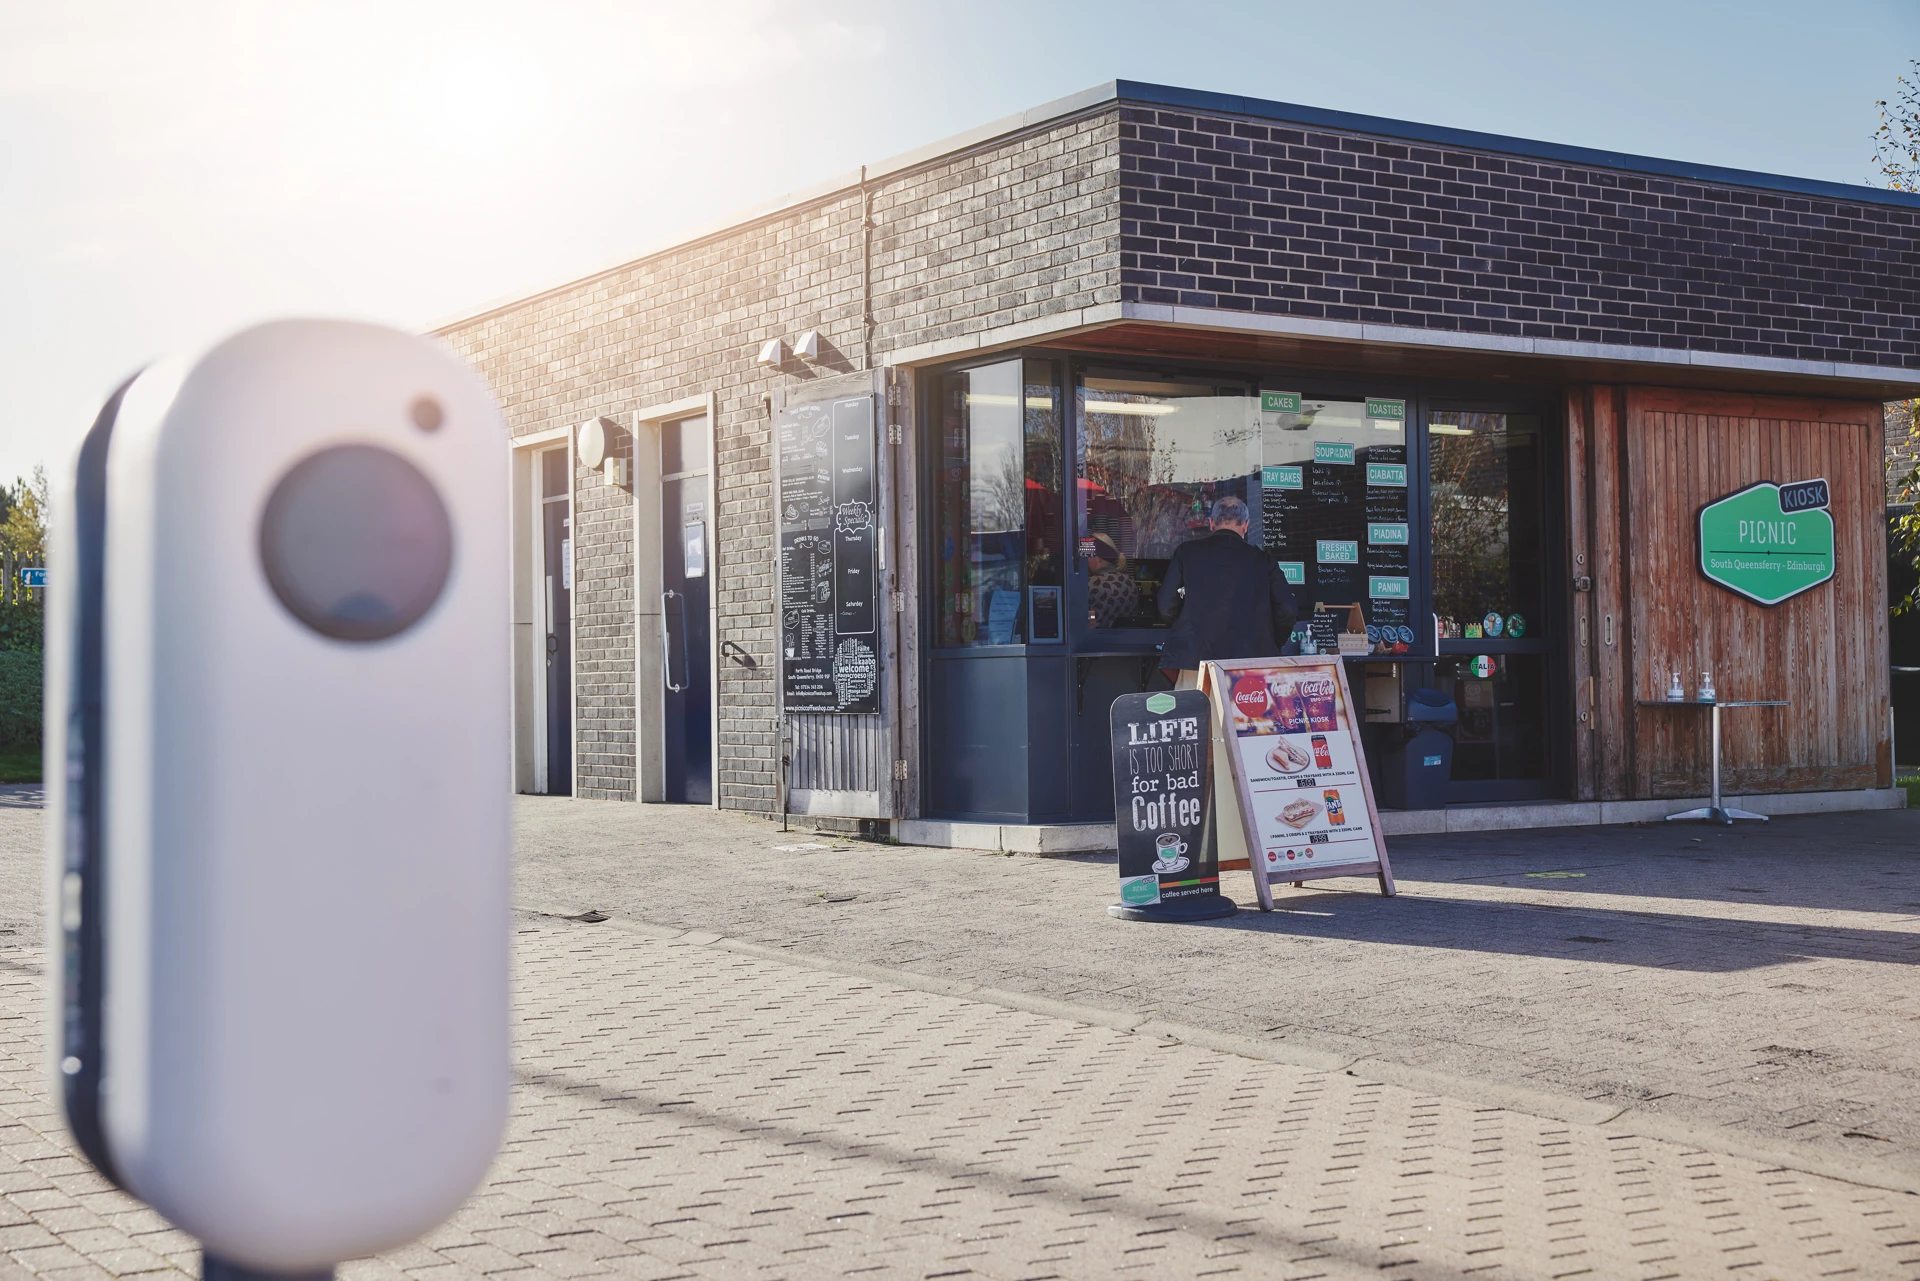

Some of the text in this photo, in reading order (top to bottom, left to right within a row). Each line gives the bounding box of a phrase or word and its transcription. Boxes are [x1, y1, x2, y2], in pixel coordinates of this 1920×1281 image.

[1268, 396, 1293, 408] CAKES
[1368, 403, 1402, 416] TOASTIES
[1316, 447, 1334, 458] SOUP
[1340, 448, 1352, 458] DAY
[1263, 472, 1300, 483] TRAY BAKES
[1370, 469, 1403, 480] CIABATTA
[1784, 486, 1825, 508] KIOSK
[842, 505, 862, 517] Weekly
[843, 516, 865, 527] Specials
[1374, 529, 1402, 539] PIADINA
[1739, 520, 1797, 545] PICNIC
[794, 536, 807, 544] DRINKS
[1321, 543, 1353, 552] FRESHLY
[1325, 552, 1350, 560] BAKED
[1711, 559, 1733, 569] South
[1734, 560, 1781, 571] Queensferry
[1787, 561, 1825, 572] Edinburgh
[1378, 582, 1401, 592] PANINI
[839, 664, 870, 673] welcome
[1301, 679, 1334, 697] Coca-Cola
[1235, 691, 1264, 704] Coca-Cola
[1128, 717, 1198, 745] LIFE
[1129, 743, 1199, 775] IS TOO SHORT
[1132, 771, 1199, 794] for bad
[1132, 792, 1200, 832] Coffee
